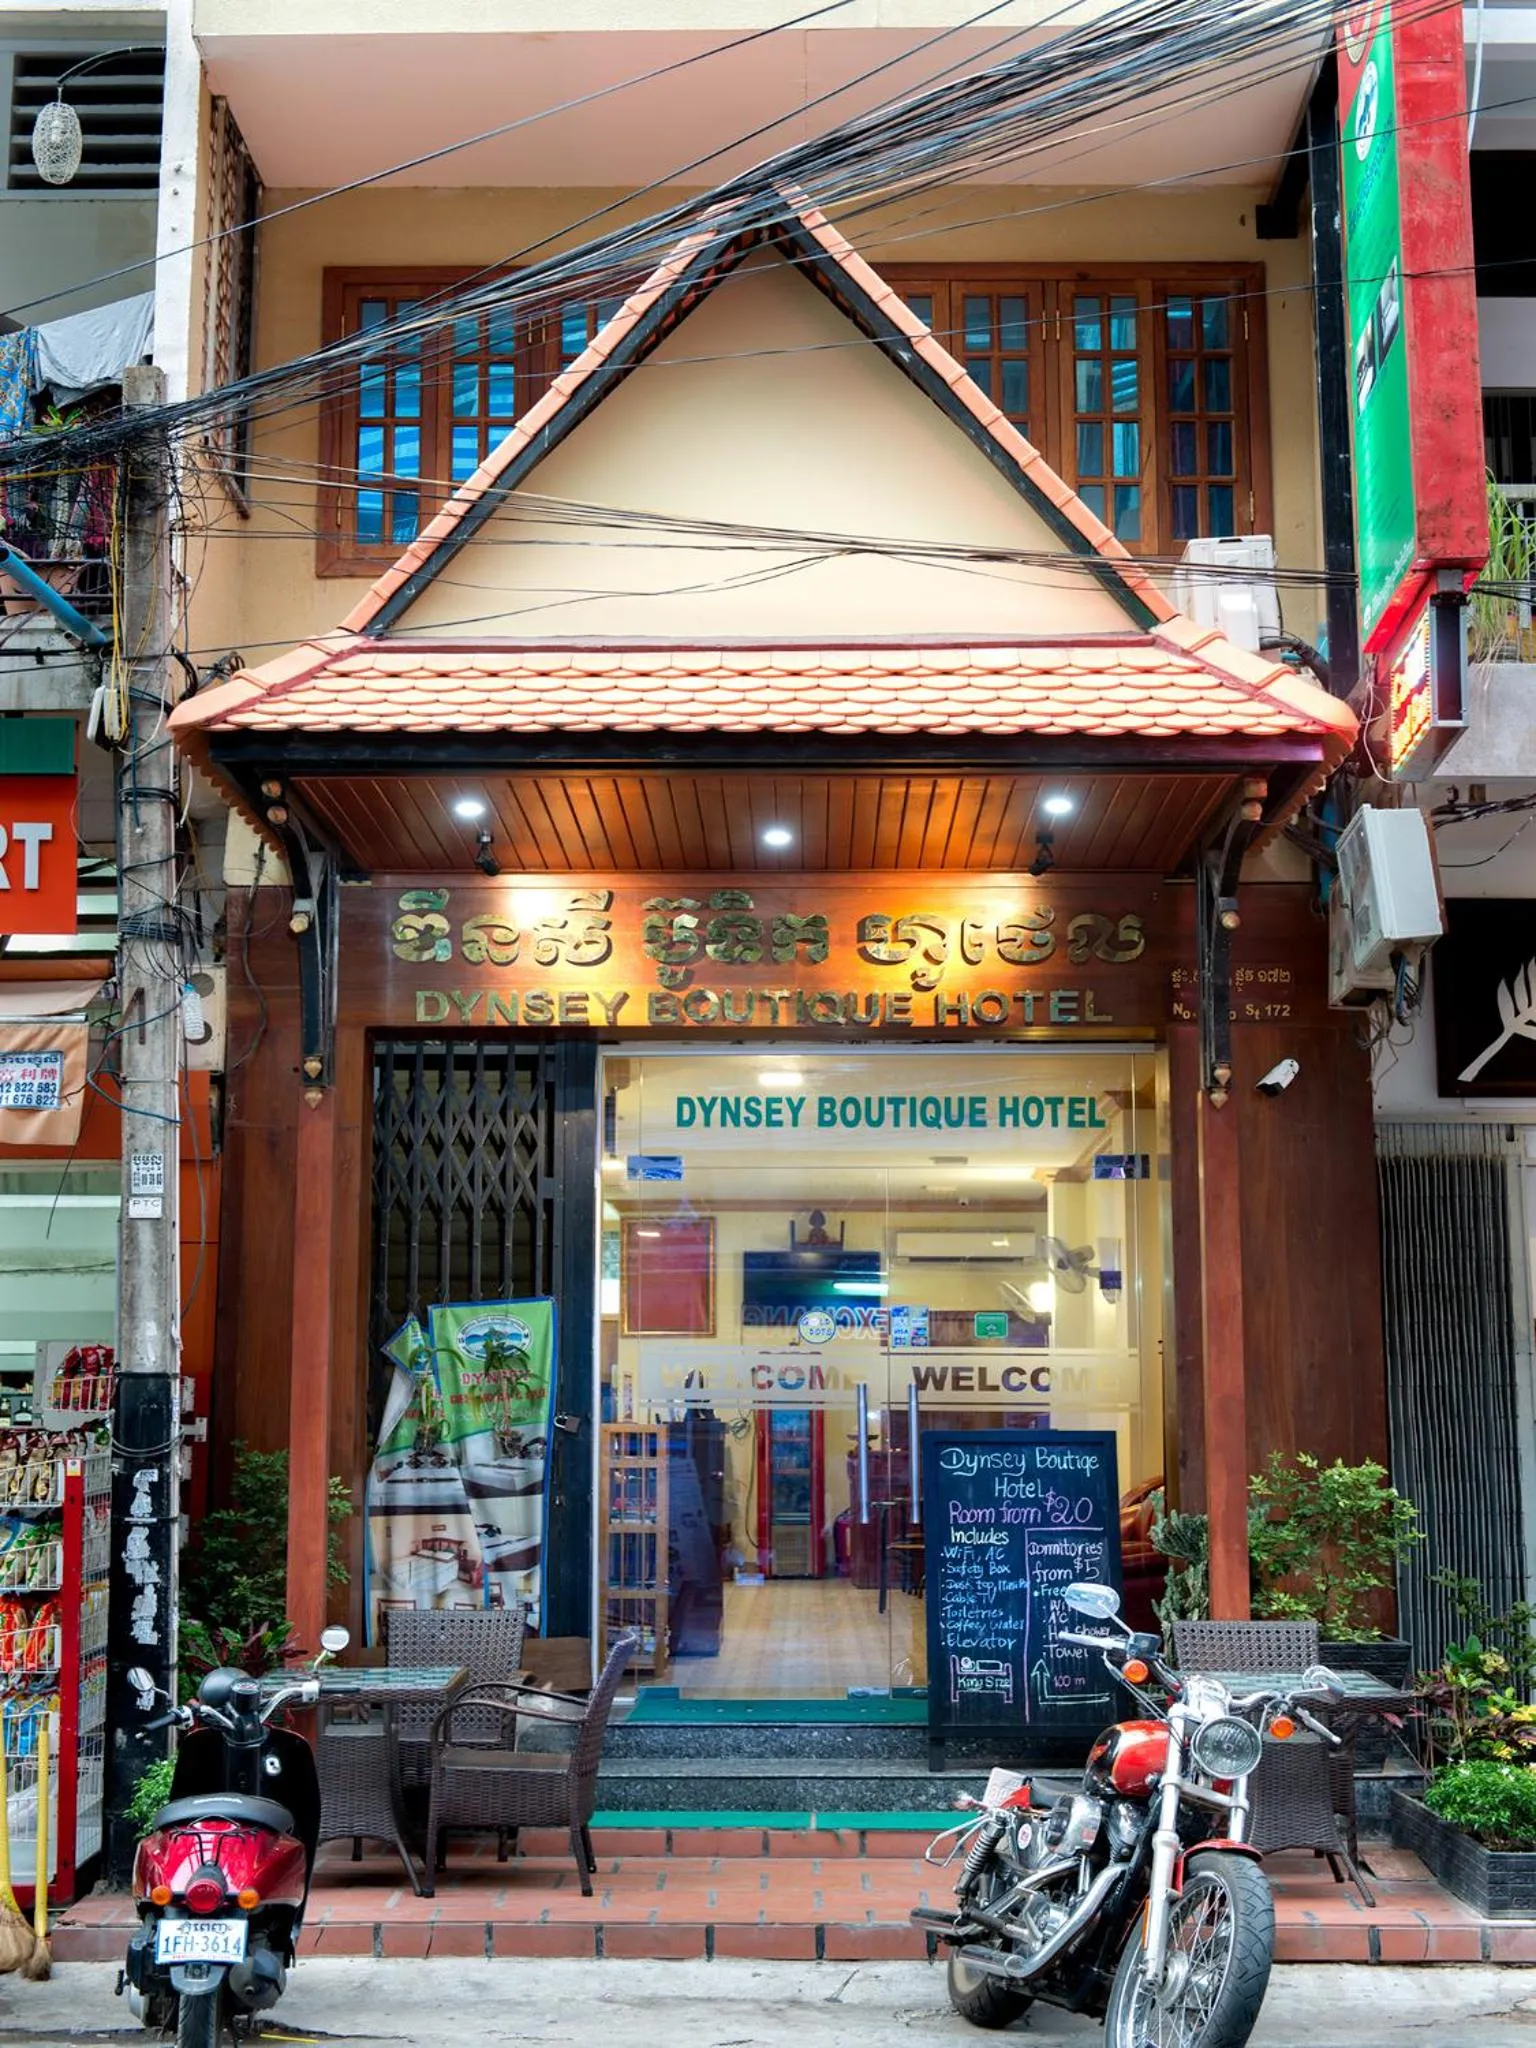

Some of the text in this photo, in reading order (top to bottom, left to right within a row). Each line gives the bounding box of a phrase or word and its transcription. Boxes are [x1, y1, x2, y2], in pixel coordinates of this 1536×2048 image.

[0, 822, 53, 890] T
[415, 988, 1112, 1024] DYNSEY BOUTIQUE HOTEL
[1264, 1004, 1291, 1017] 172
[14, 1082, 34, 1093] 822
[676, 1096, 1106, 1130] DYNSEY BOUTIQUE HOTEL
[939, 1448, 1026, 1476] Dynsey
[995, 1477, 1044, 1498] Hotel
[950, 1500, 995, 1524] Room
[1000, 1500, 1041, 1523] from
[951, 1526, 1009, 1545] Includes
[1028, 1538, 1103, 1556] Dormitories
[989, 1561, 1011, 1575] Box
[1032, 1556, 1100, 1582] from $5
[947, 1632, 1016, 1650] Elevator
[1043, 1645, 1088, 1658] Towel
[163, 1935, 242, 1956] 1FH-3614
